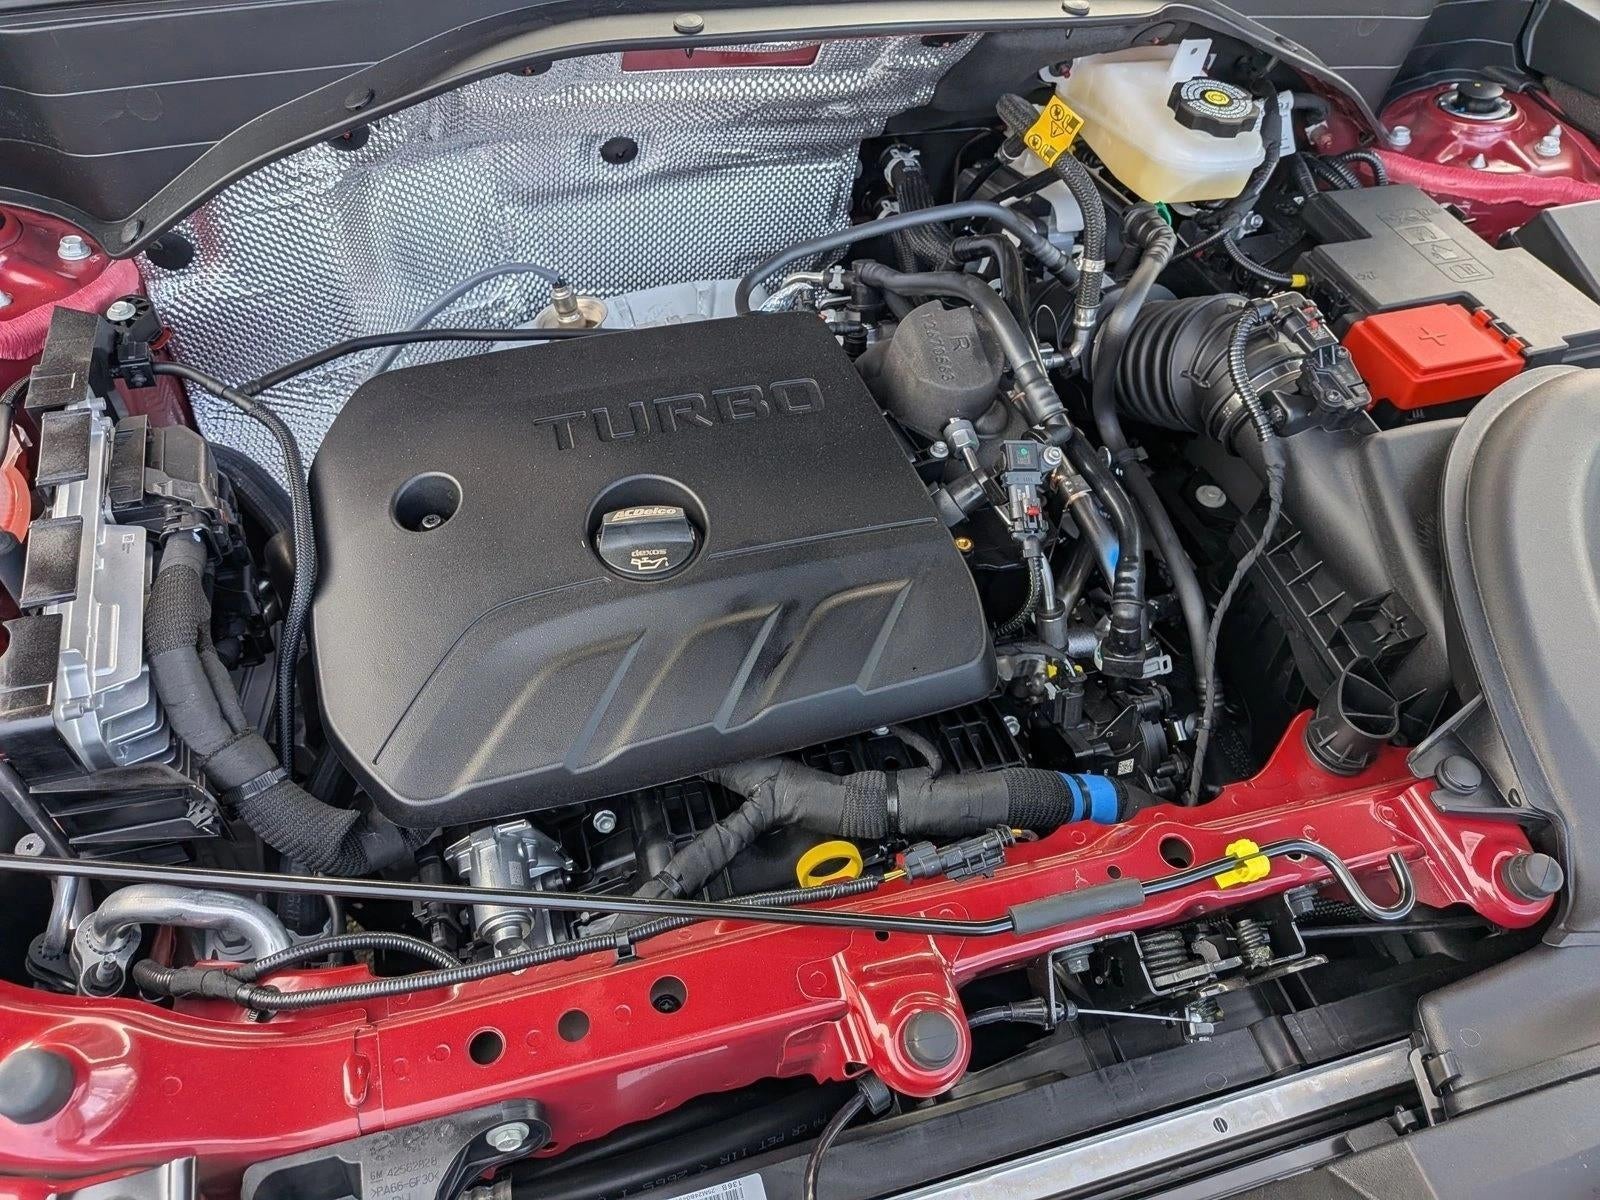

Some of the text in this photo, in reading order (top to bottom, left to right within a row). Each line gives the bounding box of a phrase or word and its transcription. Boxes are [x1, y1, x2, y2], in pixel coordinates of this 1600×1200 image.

[951, 335, 971, 352] R
[533, 378, 825, 451] TURBO
[611, 507, 678, 521] ACDelco
[631, 549, 668, 558] dexos
